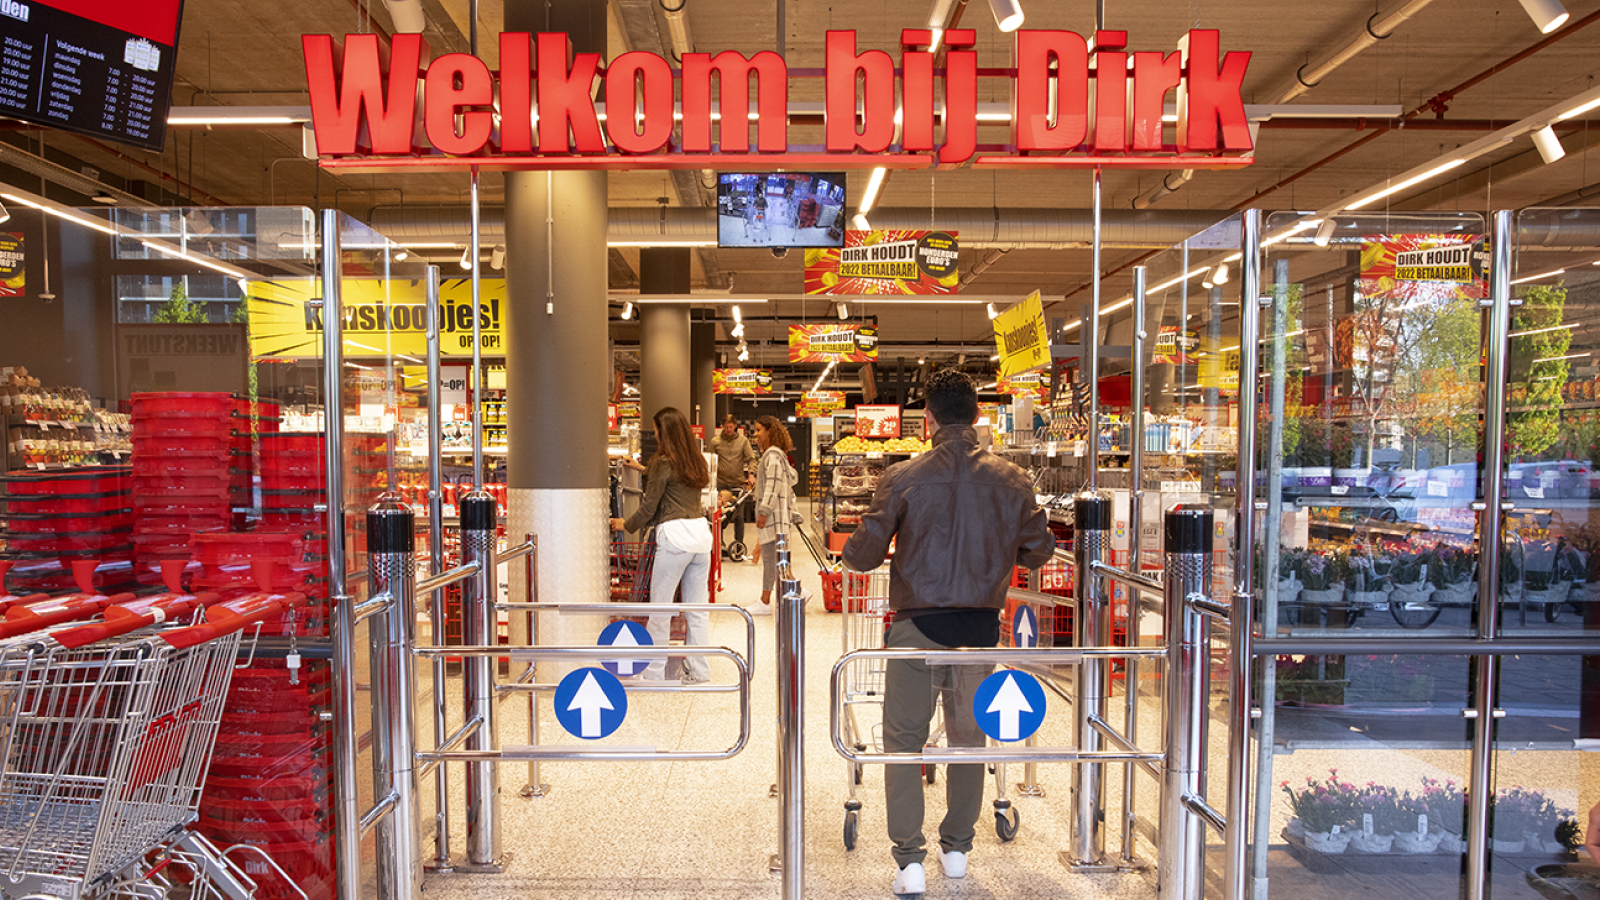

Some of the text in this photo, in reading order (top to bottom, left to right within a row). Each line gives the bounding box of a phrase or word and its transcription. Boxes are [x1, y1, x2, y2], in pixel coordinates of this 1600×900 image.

[4, 36, 22, 48] 20.00
[56, 39, 105, 60] Volgende week
[1, 66, 19, 77] 20.00
[108, 67, 120, 76] 7.00
[0, 77, 18, 87] 21.00
[107, 76, 119, 85] 7.00
[106, 85, 118, 94] 7.00
[105, 94, 117, 104] 7.00
[301, 28, 1254, 163] Welkom bij Dirk
[104, 103, 116, 113] 7.00
[103, 112, 115, 121] 7.00
[101, 122, 114, 131] 8.00
[842, 245, 915, 261] DIRK HOUDT
[1398, 252, 1423, 265] DIRK
[1427, 248, 1470, 264] HOUDT
[841, 264, 860, 275] 2022
[861, 263, 916, 278] BETAALBAAR!
[1396, 267, 1470, 281] 2022 BETAALBAAR!
[304, 299, 499, 333] Knskoojes!
[459, 334, 500, 348] OPOP!
[810, 335, 825, 343] DIRK
[826, 333, 852, 342] HOUDT
[440, 379, 465, 390] =OP!
[245, 861, 269, 874] Dirk
